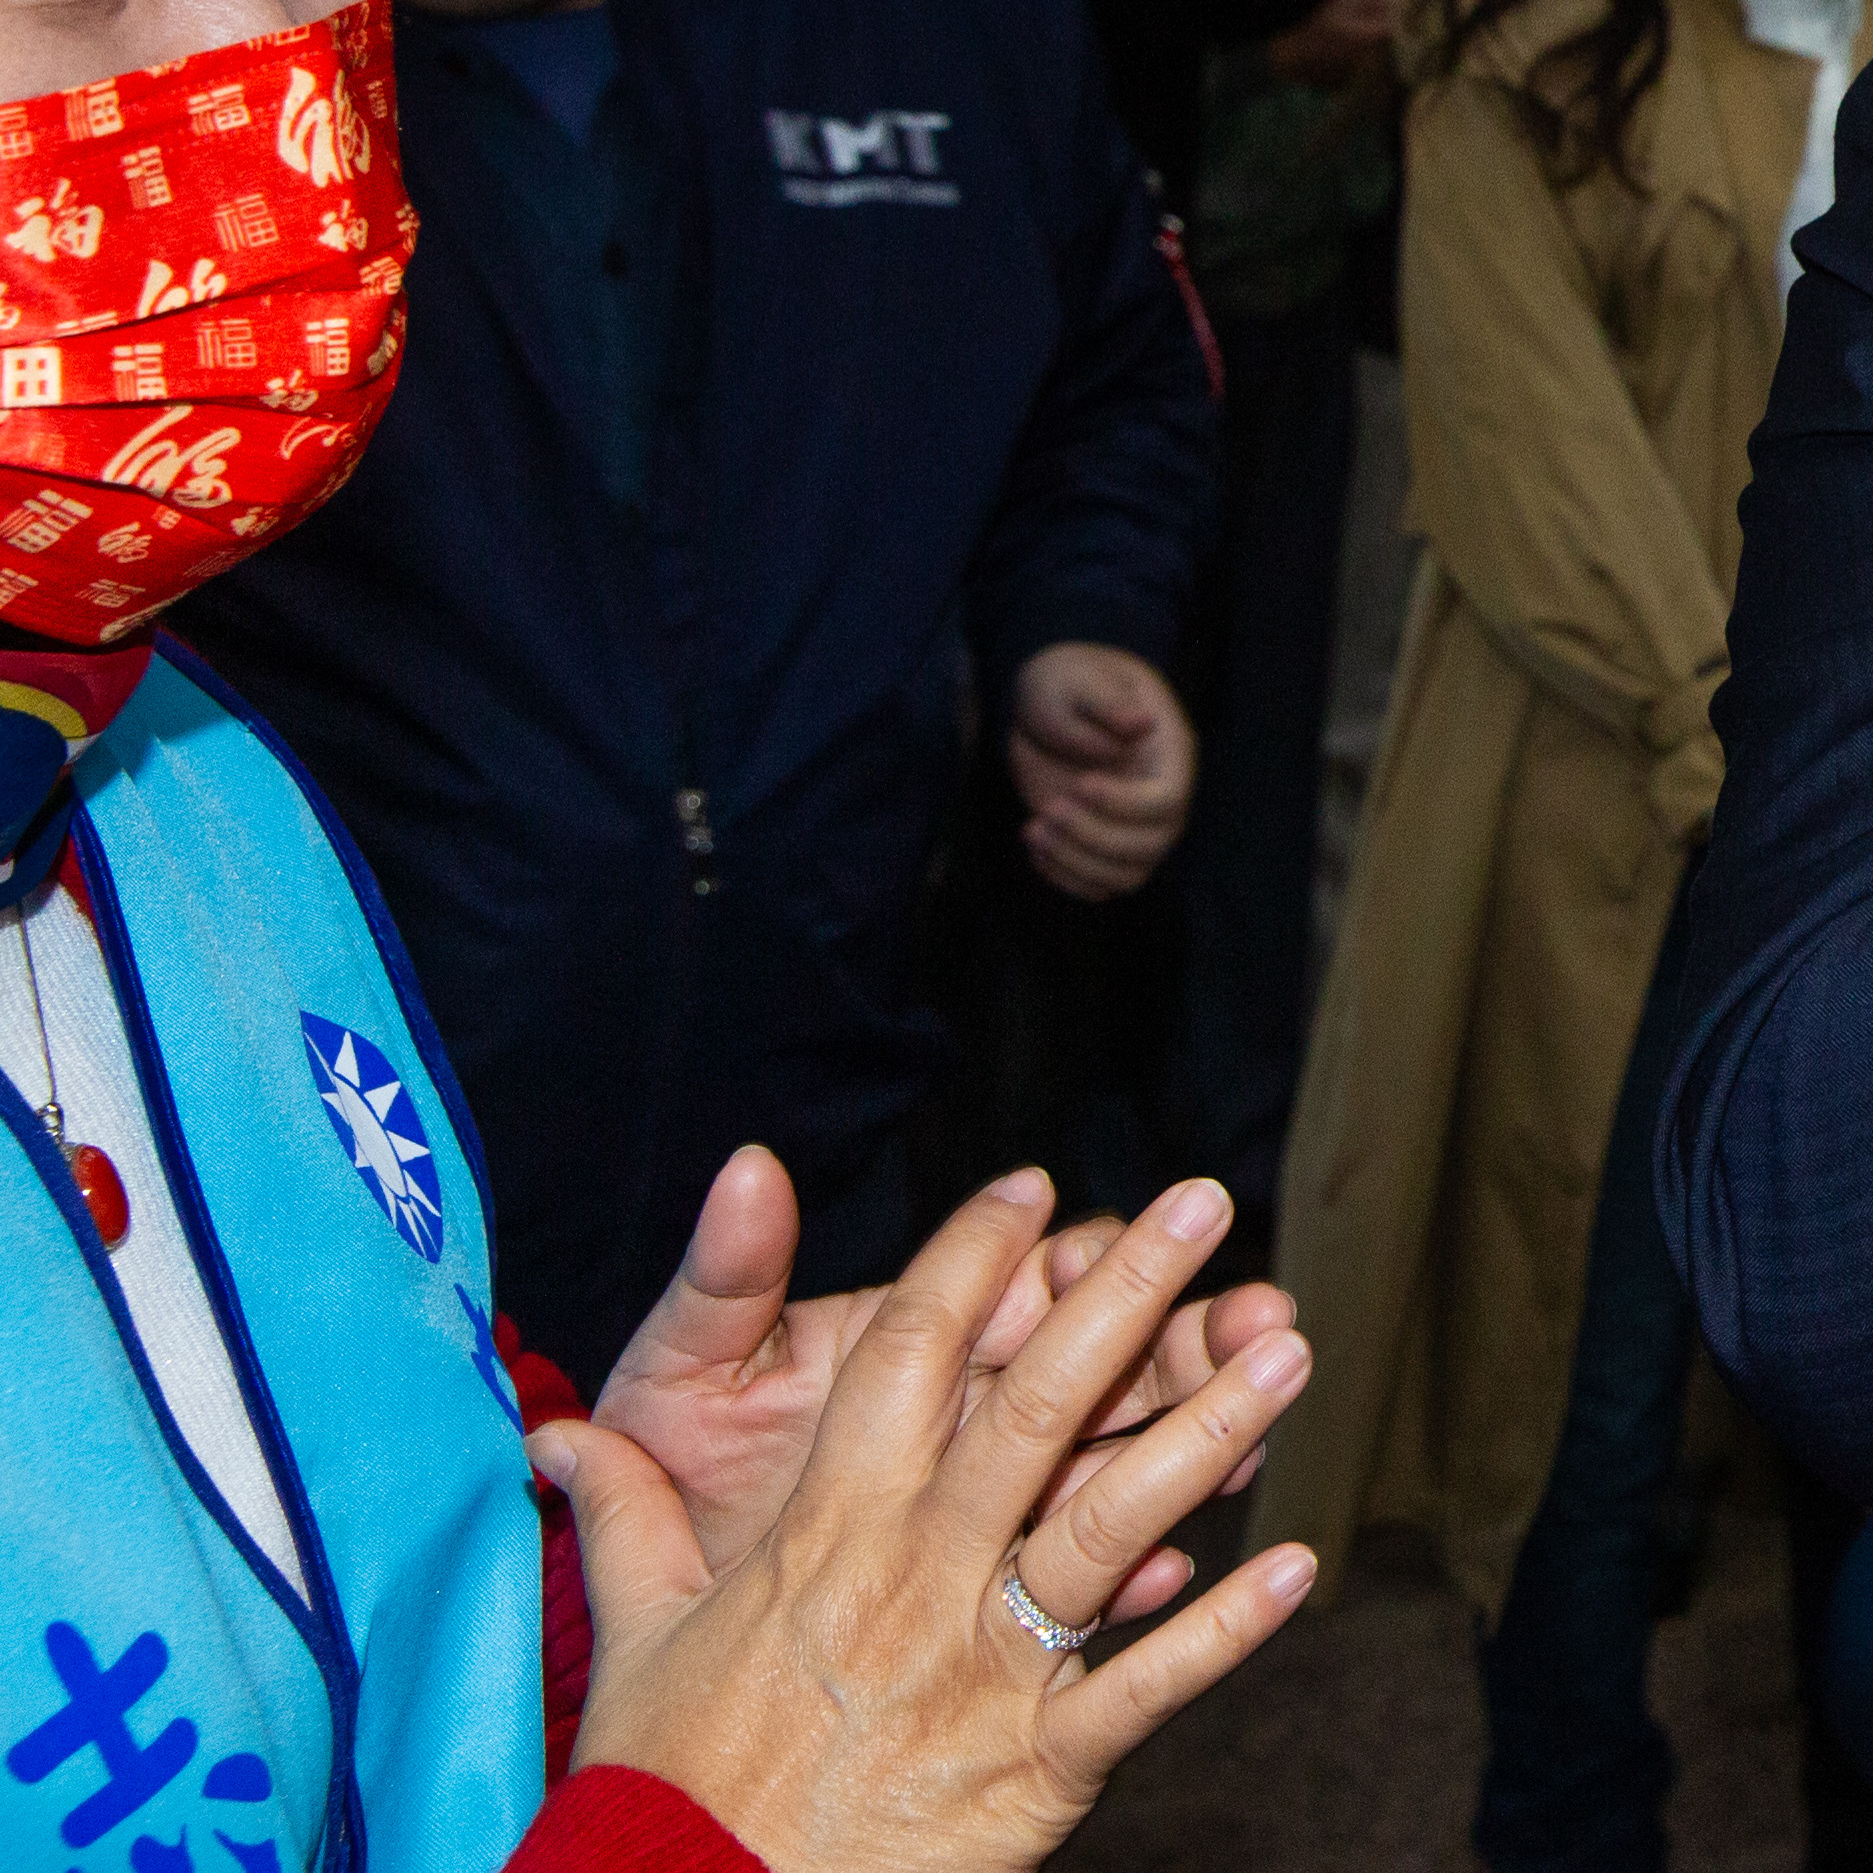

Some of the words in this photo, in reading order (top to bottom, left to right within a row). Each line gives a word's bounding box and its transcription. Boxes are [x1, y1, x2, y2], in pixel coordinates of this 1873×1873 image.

[187, 83, 252, 136] 福
[120, 145, 173, 210] 福
[213, 192, 280, 253] 福
[111, 343, 168, 401] 福
[197, 319, 257, 369] 福
[304, 317, 351, 377] 福
